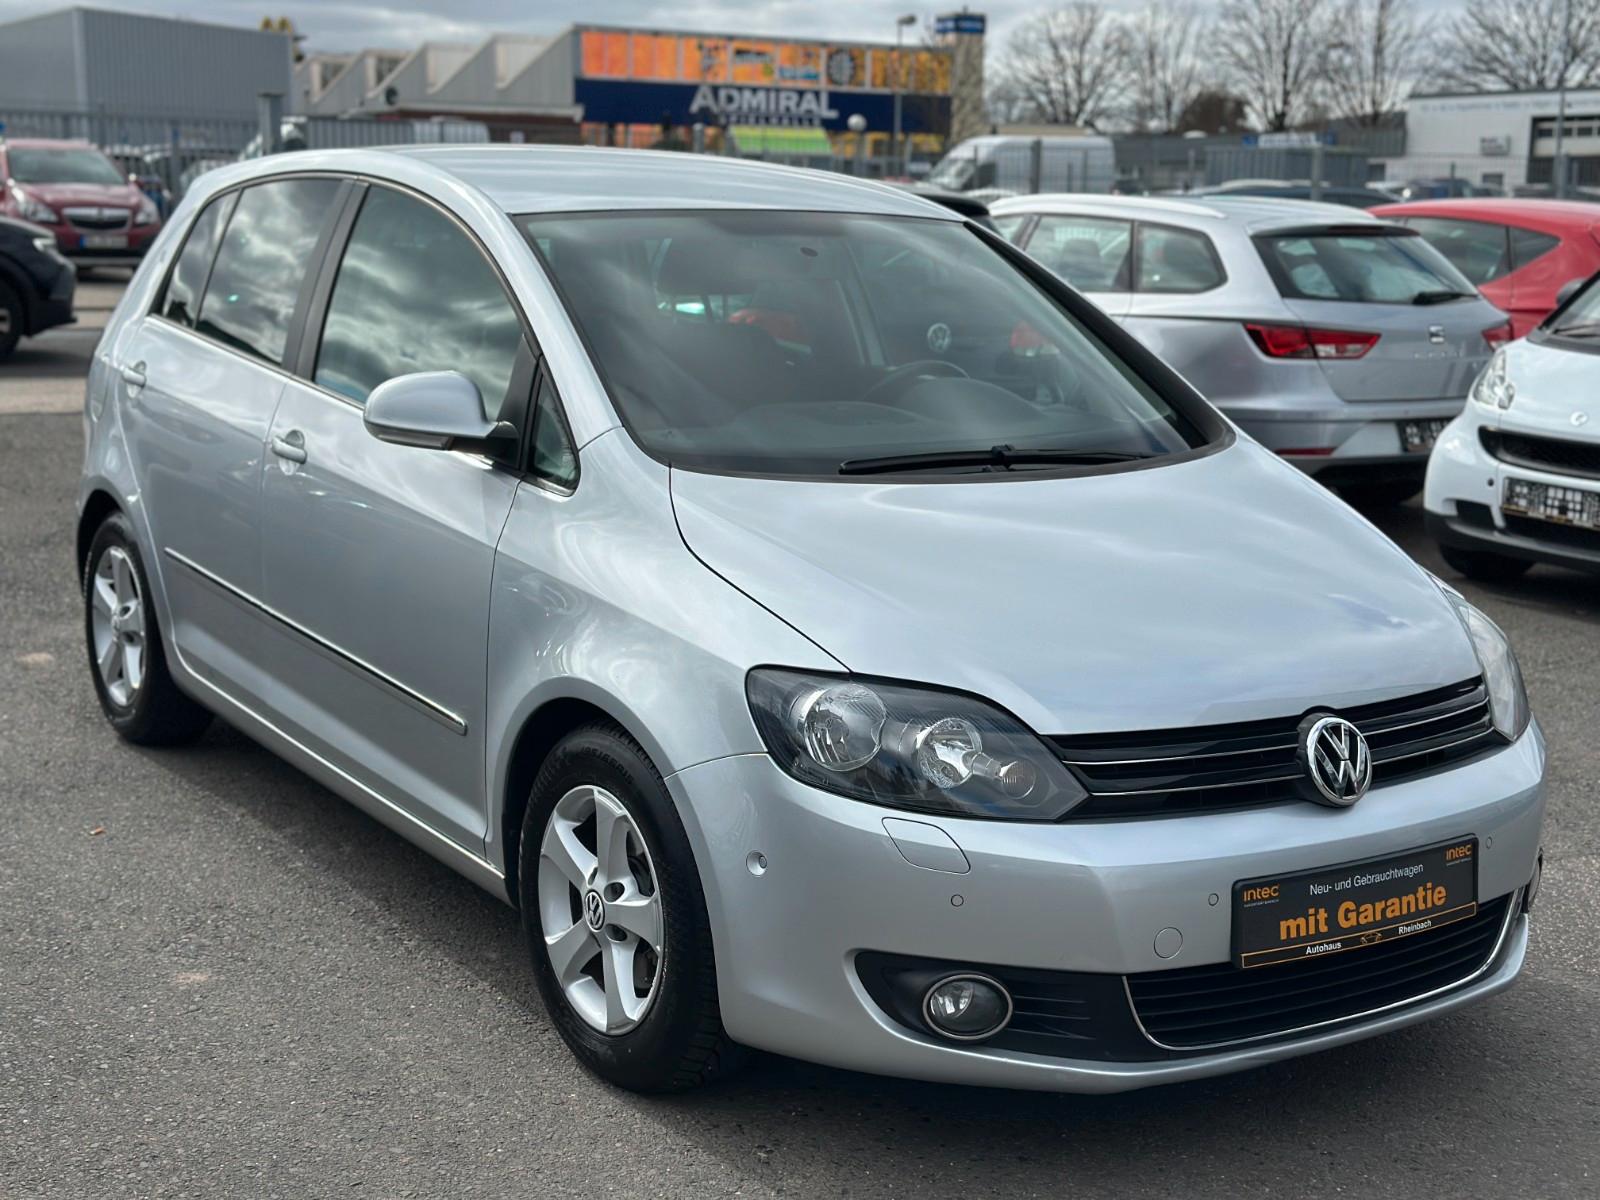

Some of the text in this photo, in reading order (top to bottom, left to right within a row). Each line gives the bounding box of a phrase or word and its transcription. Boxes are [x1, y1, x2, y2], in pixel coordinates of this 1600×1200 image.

[689, 85, 839, 119] ADMIRAL
[1310, 863, 1424, 896] Neu- und Gebrauchtwagen
[1279, 882, 1447, 941] mit Garantie
[1306, 919, 1432, 955] Autohaus Rheinbach
